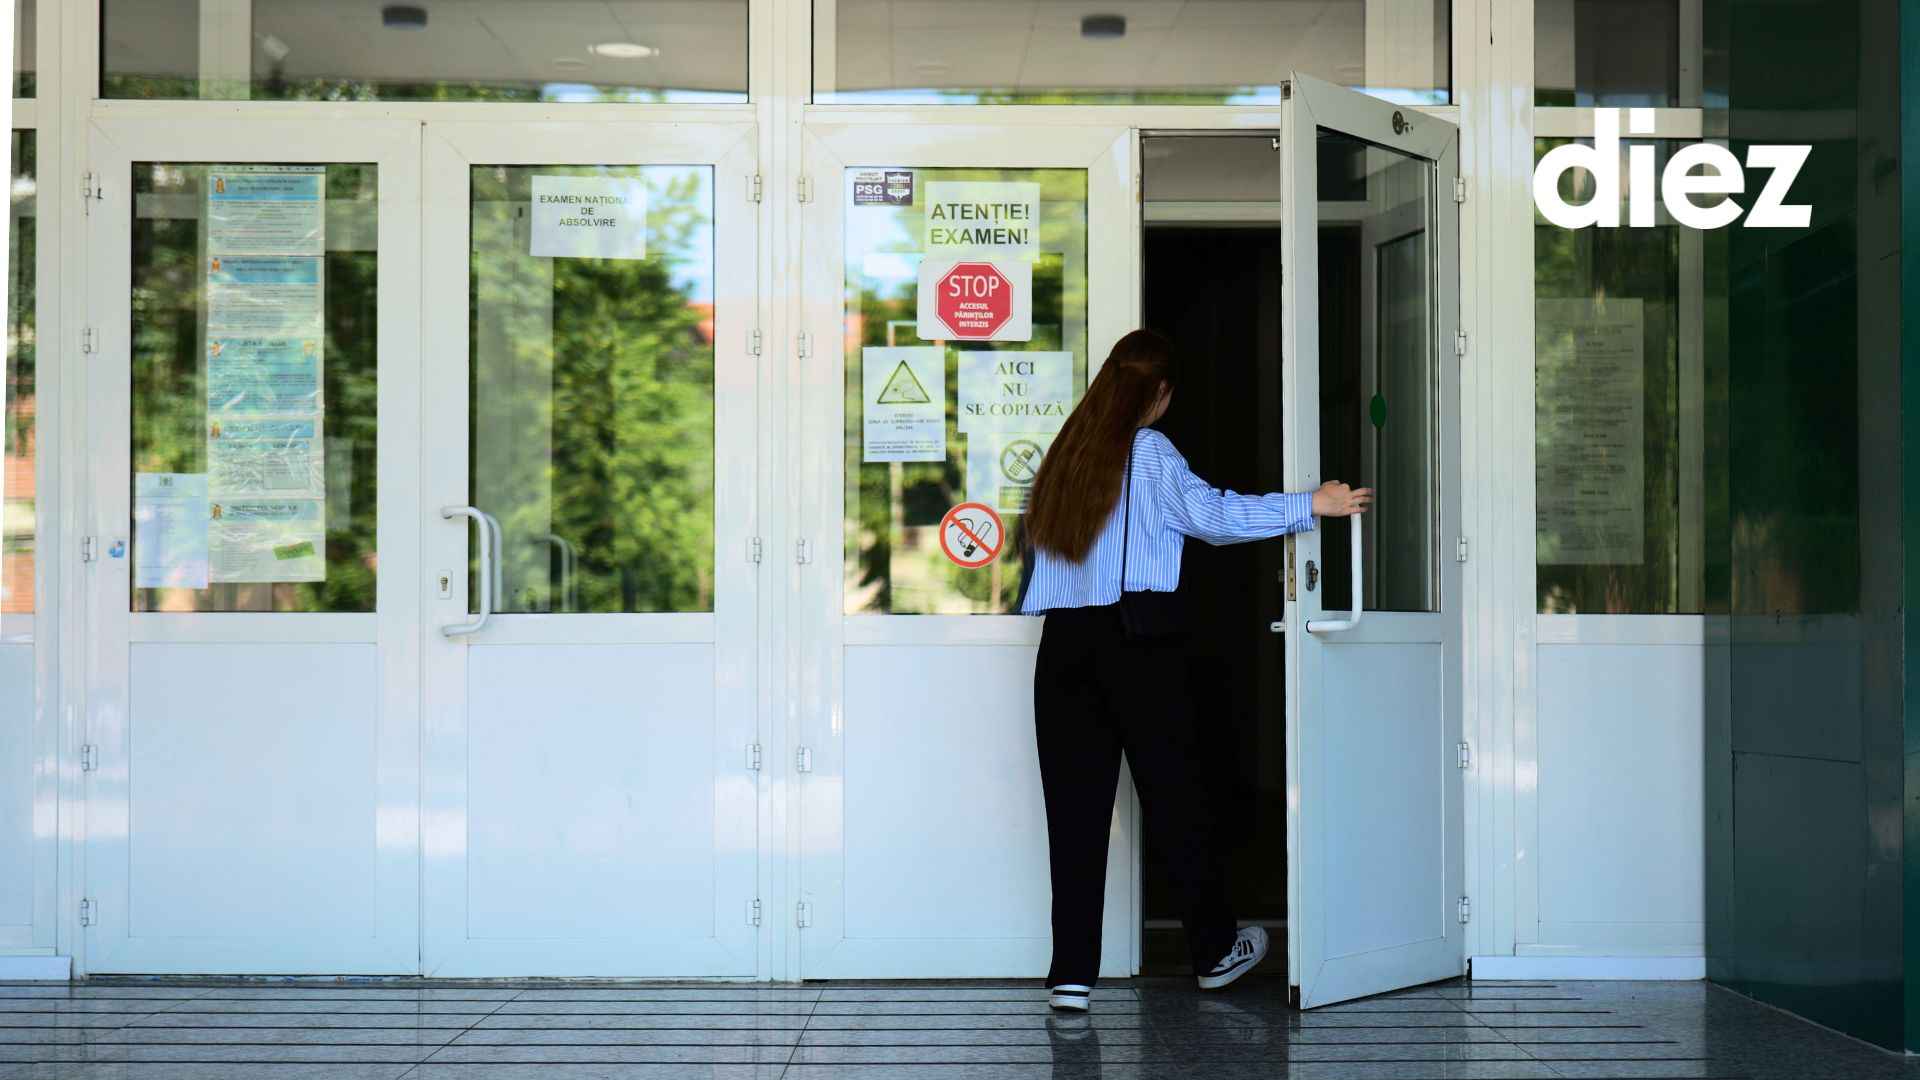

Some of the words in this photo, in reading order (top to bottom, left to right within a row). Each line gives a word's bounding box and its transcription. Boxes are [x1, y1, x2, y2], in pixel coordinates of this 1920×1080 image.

[856, 184, 883, 194] PSG
[540, 195, 582, 204] EXAMEN
[581, 207, 595, 215] DE
[931, 203, 1029, 223] ATENȚIE!
[559, 218, 617, 227] ABSOLVIRE
[931, 228, 1028, 245] EXAMEN!
[949, 275, 1000, 297] STOP
[959, 302, 989, 310] ACCESUL
[959, 320, 989, 328] INTERZIS
[995, 361, 1036, 376] AICI
[1002, 383, 1028, 397] NU
[966, 403, 985, 416] SE
[990, 400, 1064, 416] COPIAZĂ
